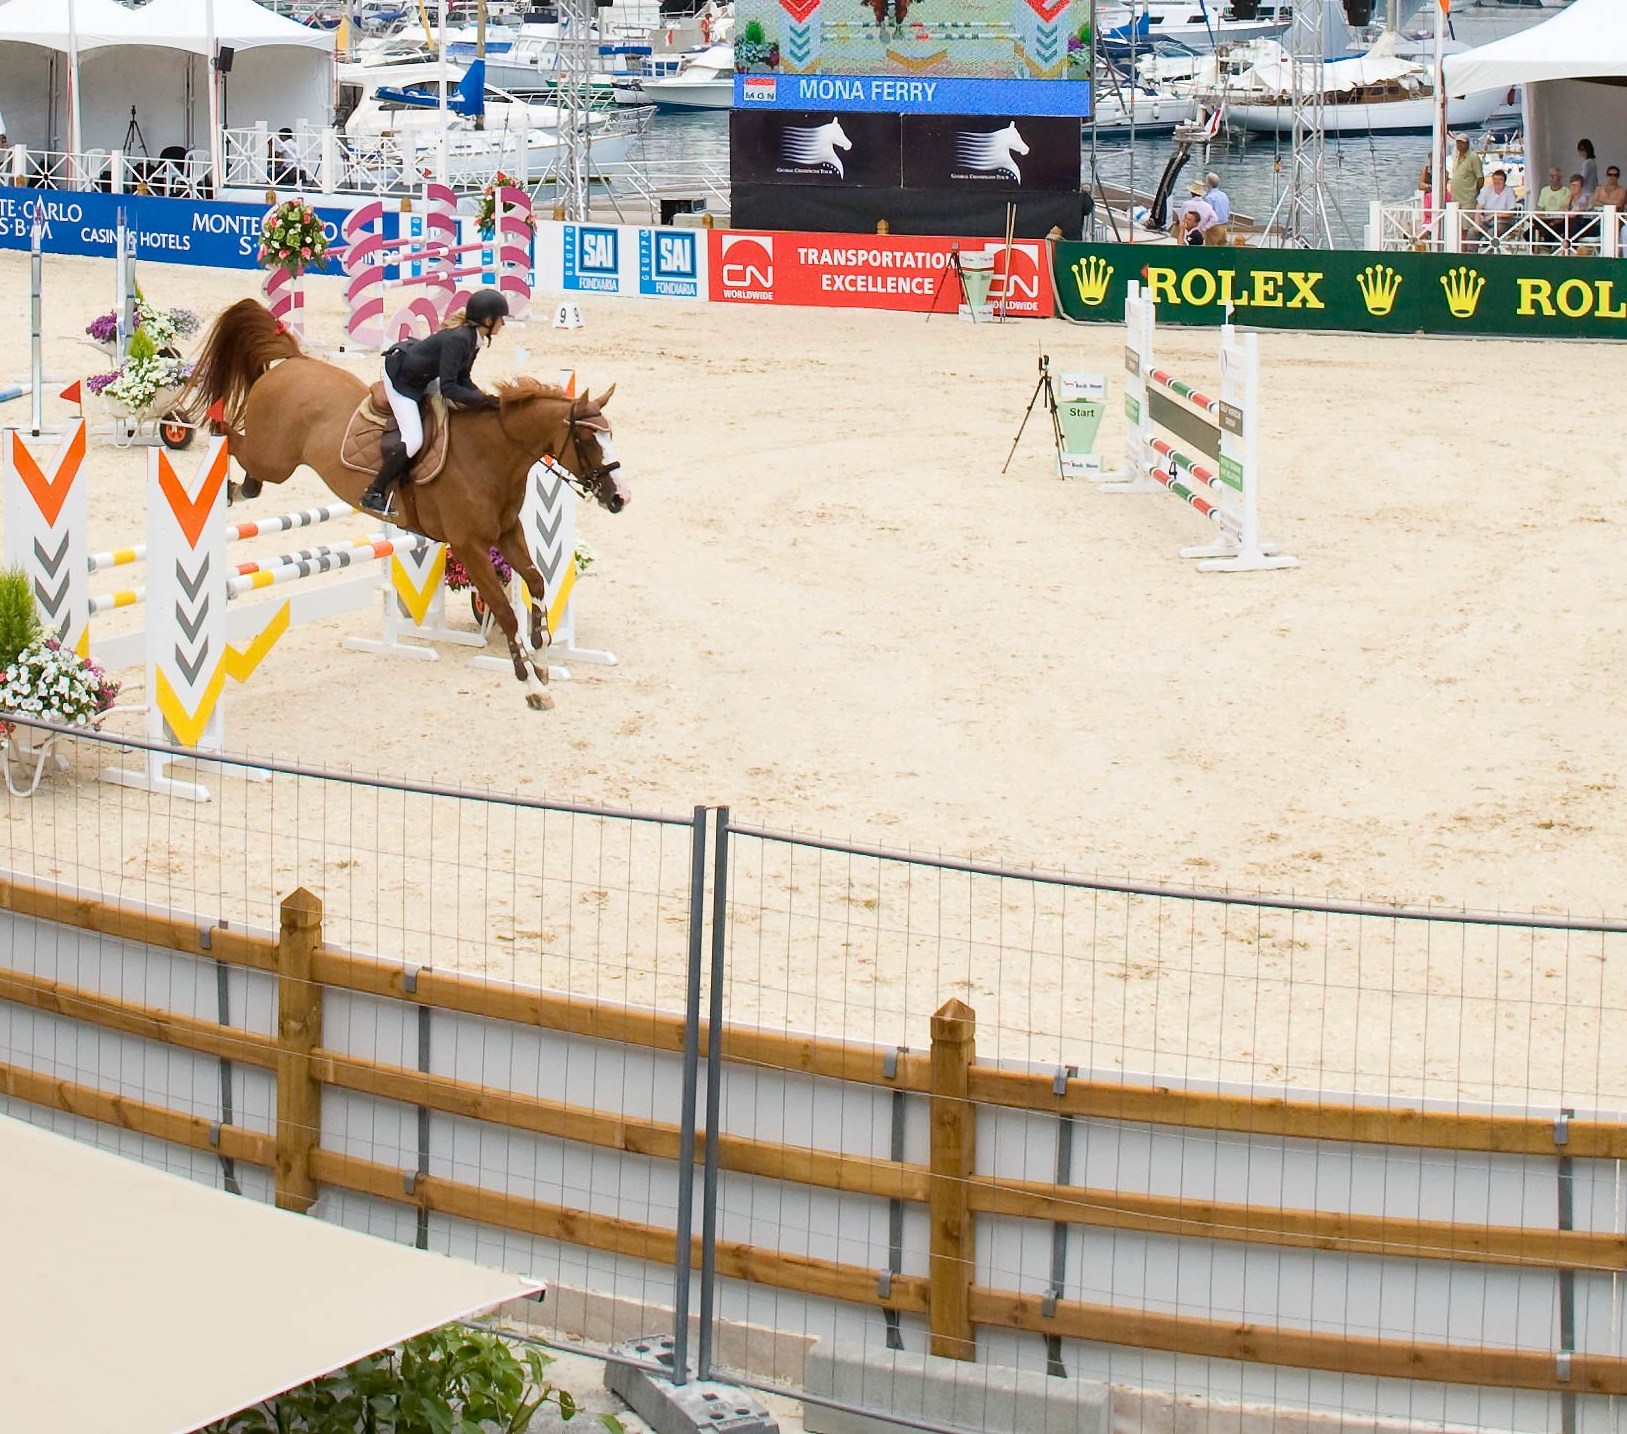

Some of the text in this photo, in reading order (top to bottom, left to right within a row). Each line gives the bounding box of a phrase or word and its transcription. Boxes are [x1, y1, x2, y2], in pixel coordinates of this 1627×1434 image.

[799, 79, 937, 103] MONA FERRY
[139, 231, 191, 251] HOTELS
[582, 233, 614, 268] SAI
[660, 238, 692, 273] SAI
[797, 247, 958, 270] TRANSPORTATION
[578, 278, 618, 291] FONDIARIA
[722, 264, 774, 288] CN
[821, 274, 935, 296] EXCELLENCE
[1147, 266, 1325, 308] ROLEX
[655, 281, 696, 296] FONDIARIA
[723, 289, 774, 301] WORLDWIDE
[1069, 407, 1095, 418] Start
